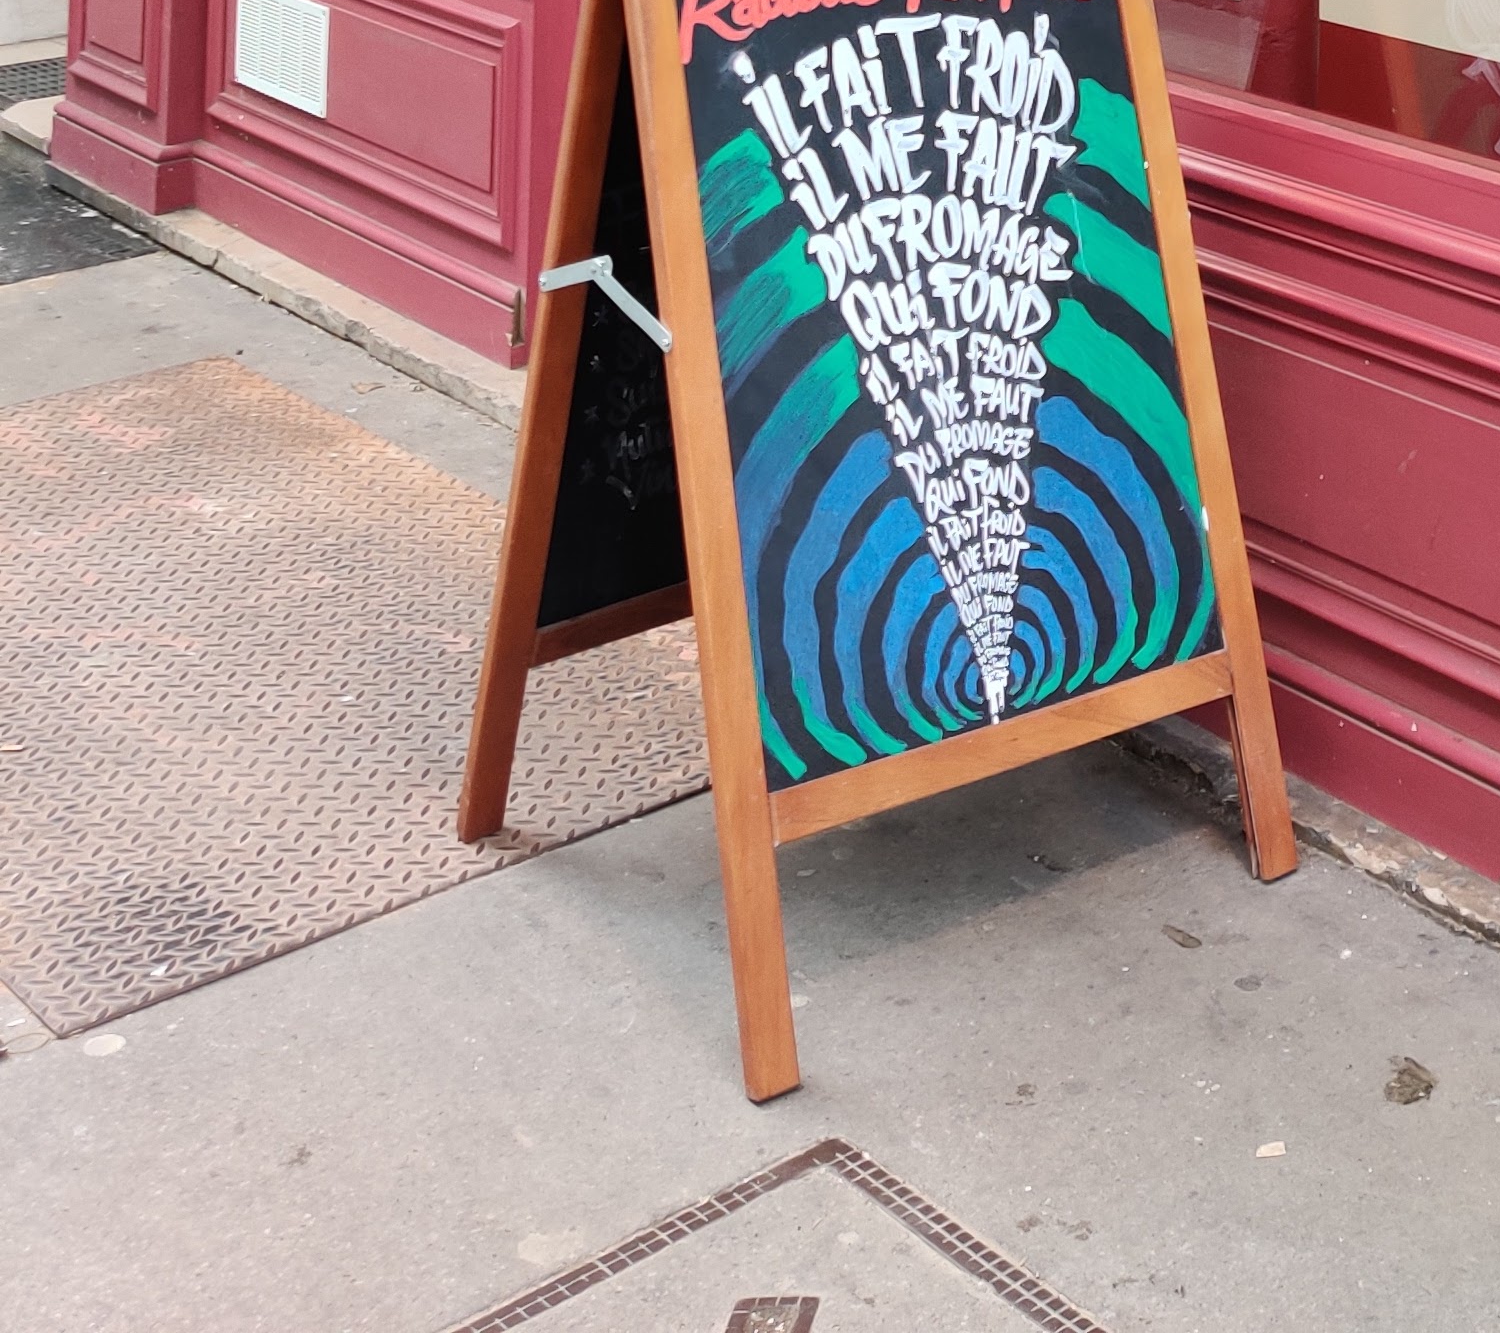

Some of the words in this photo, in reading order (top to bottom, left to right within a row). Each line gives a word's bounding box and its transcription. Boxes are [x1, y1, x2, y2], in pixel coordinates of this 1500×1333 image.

[831, 115, 932, 201] ME
[934, 110, 1077, 216] FAUT
[807, 213, 878, 301] DU
[860, 194, 1074, 283] FROMAGE
[927, 262, 1051, 339] FOND
[920, 376, 970, 429] ME
[970, 376, 1045, 423] FAUT
[893, 442, 941, 503] DU
[934, 420, 1034, 466] FROMAGE
[962, 458, 1030, 509] FOND
[983, 538, 1031, 574] FAUT
